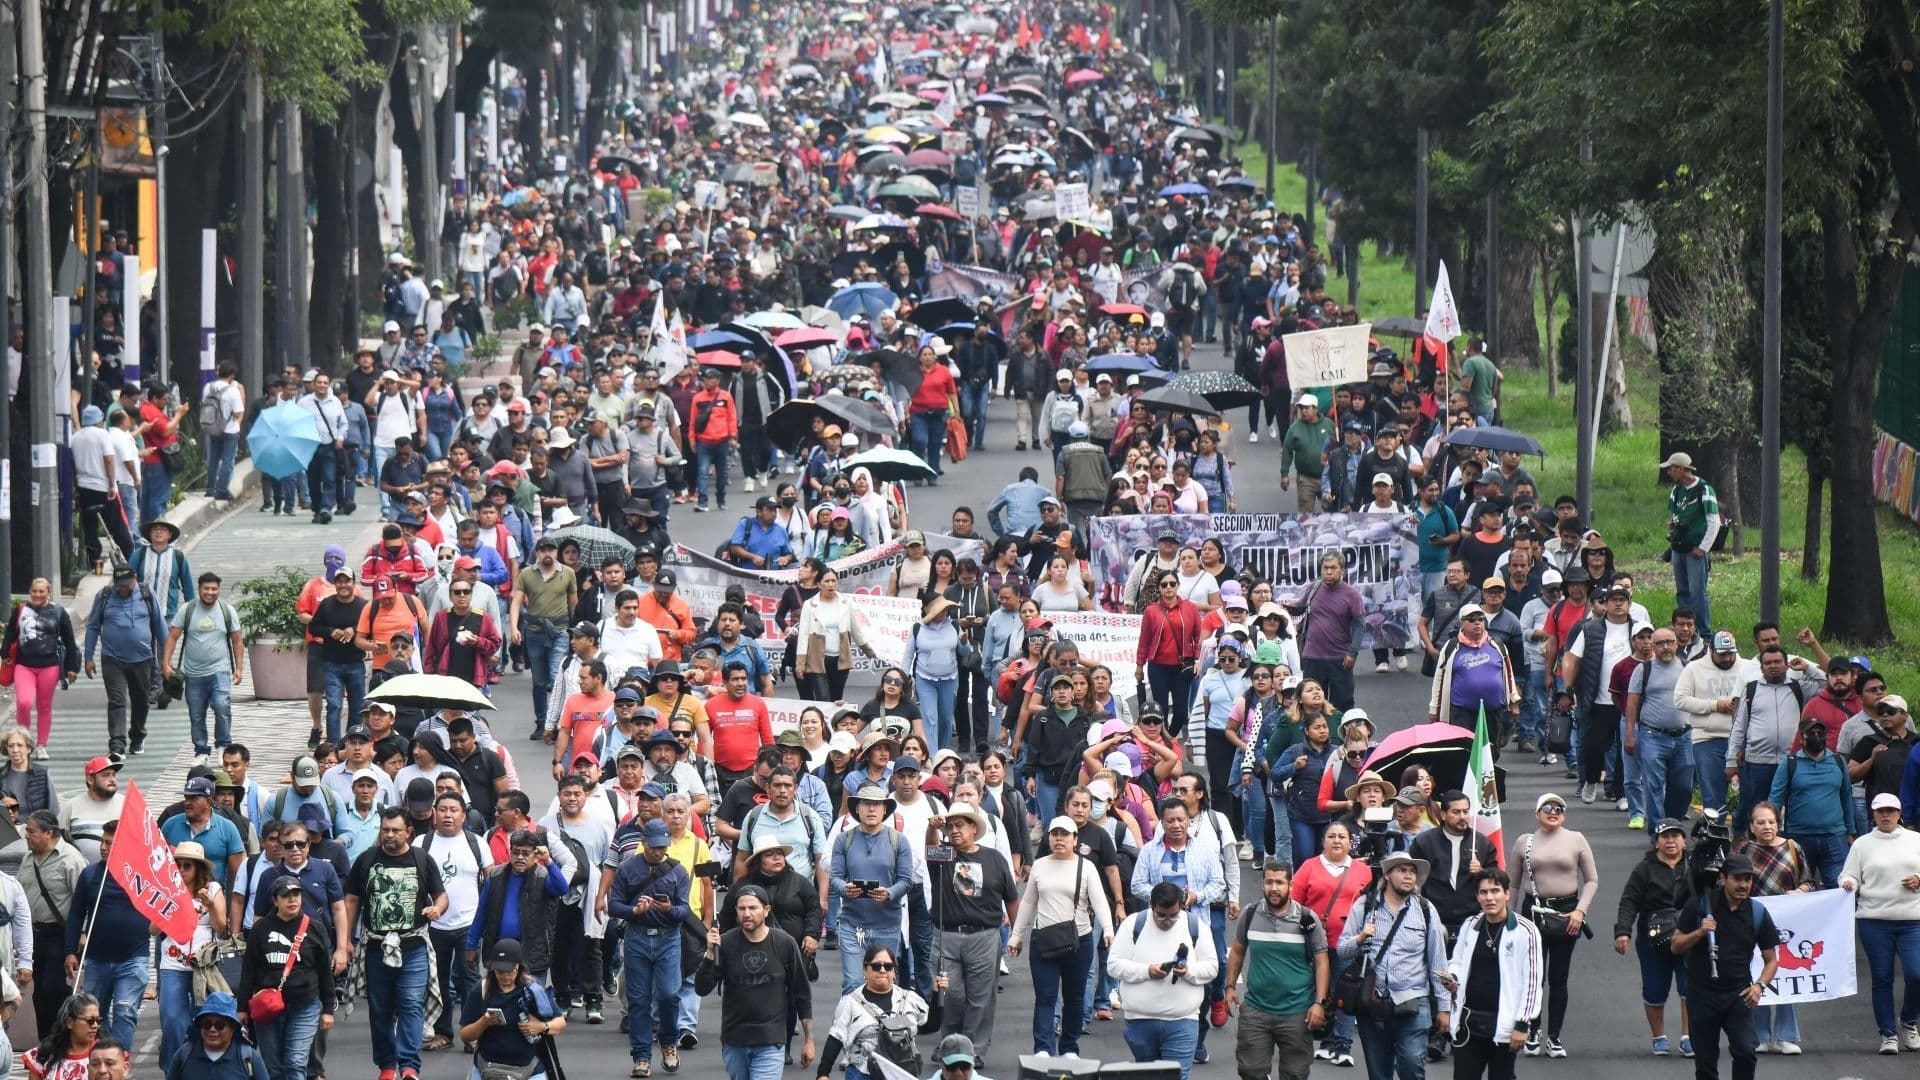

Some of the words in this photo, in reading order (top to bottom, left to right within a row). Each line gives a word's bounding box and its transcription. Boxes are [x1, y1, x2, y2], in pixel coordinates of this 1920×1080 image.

[1256, 515, 1277, 531] XXII
[1241, 544, 1390, 586] HUAJUPAN
[1089, 631, 1109, 642] 401
[1760, 973, 1828, 997] NTE
